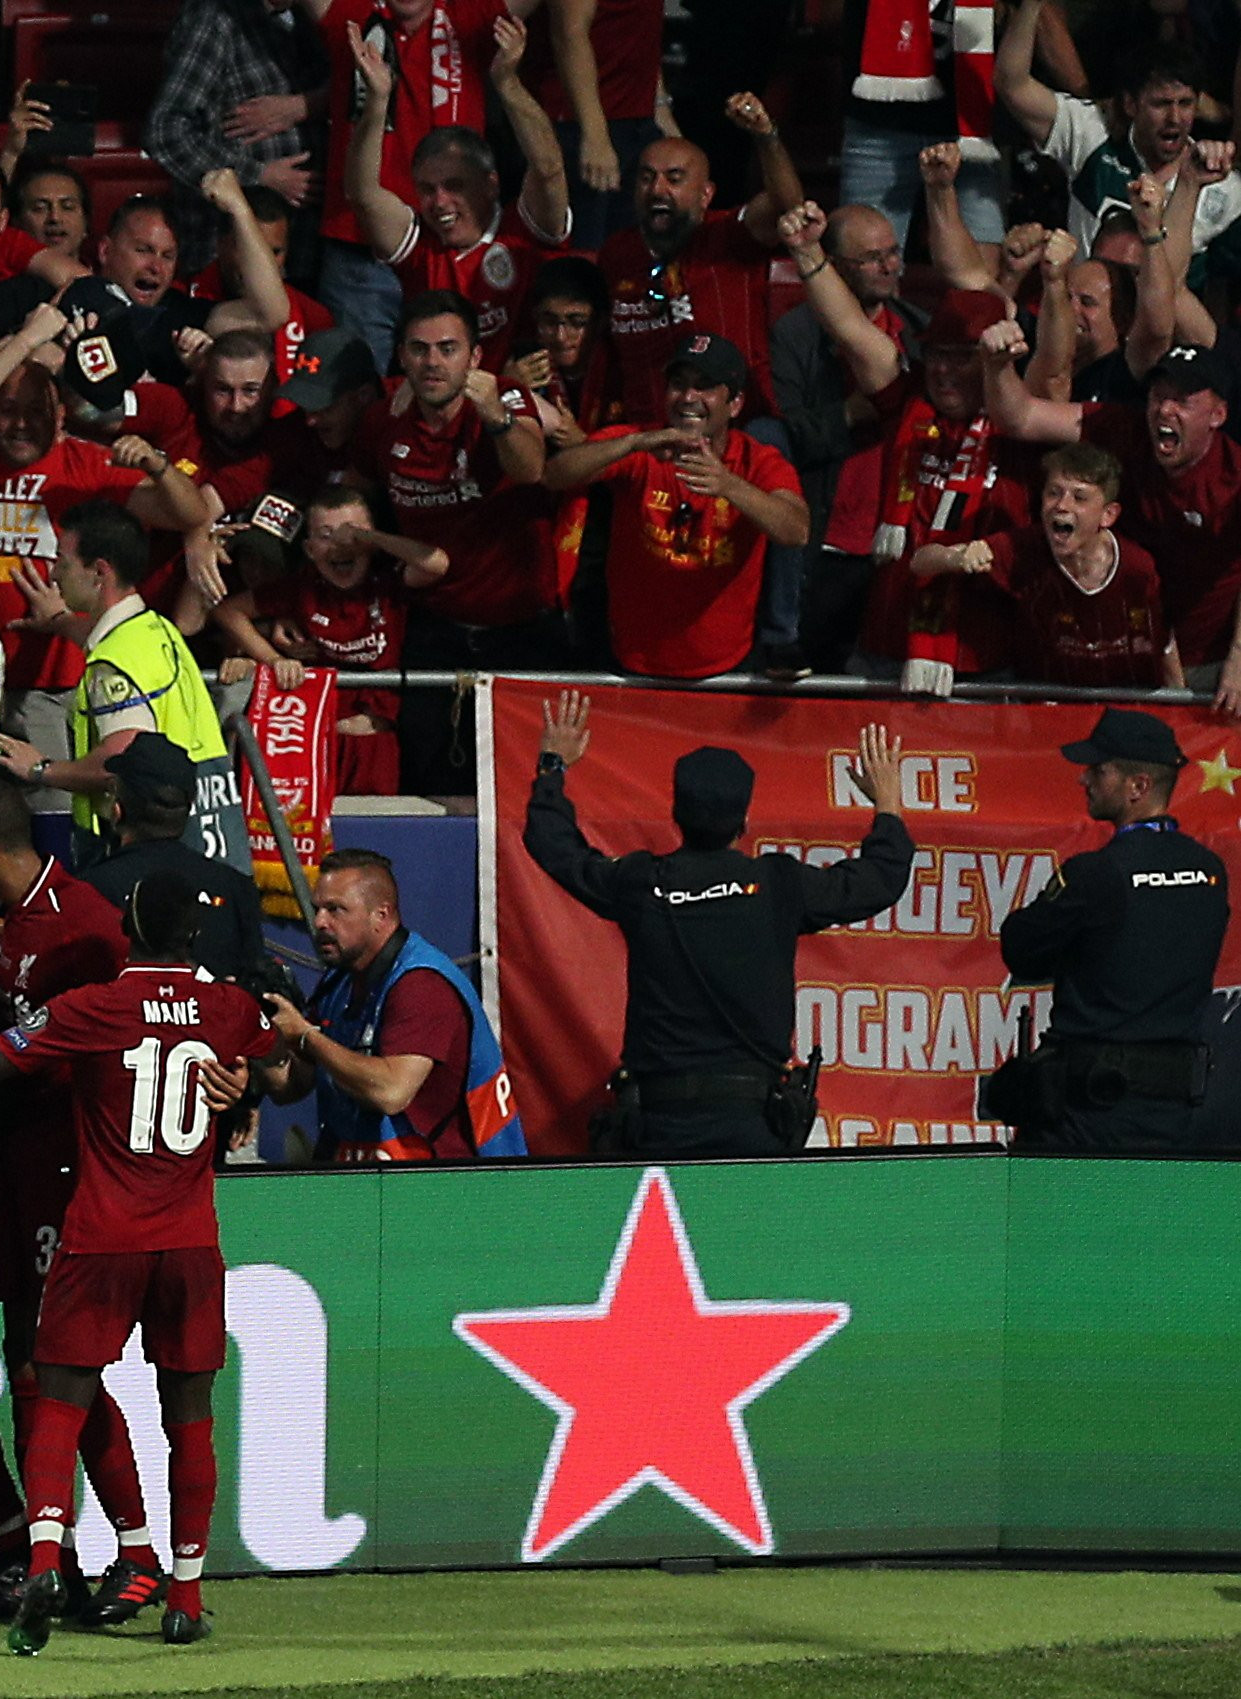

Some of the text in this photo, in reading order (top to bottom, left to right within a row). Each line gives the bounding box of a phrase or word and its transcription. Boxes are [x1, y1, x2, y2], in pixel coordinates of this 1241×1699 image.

[266, 695, 307, 757] THIS
[833, 755, 973, 811] NCE
[1132, 870, 1209, 888] POLICIA
[143, 997, 201, 1026] MANÉ
[795, 985, 1054, 1072] OGRAM
[123, 1037, 218, 1155] 10
